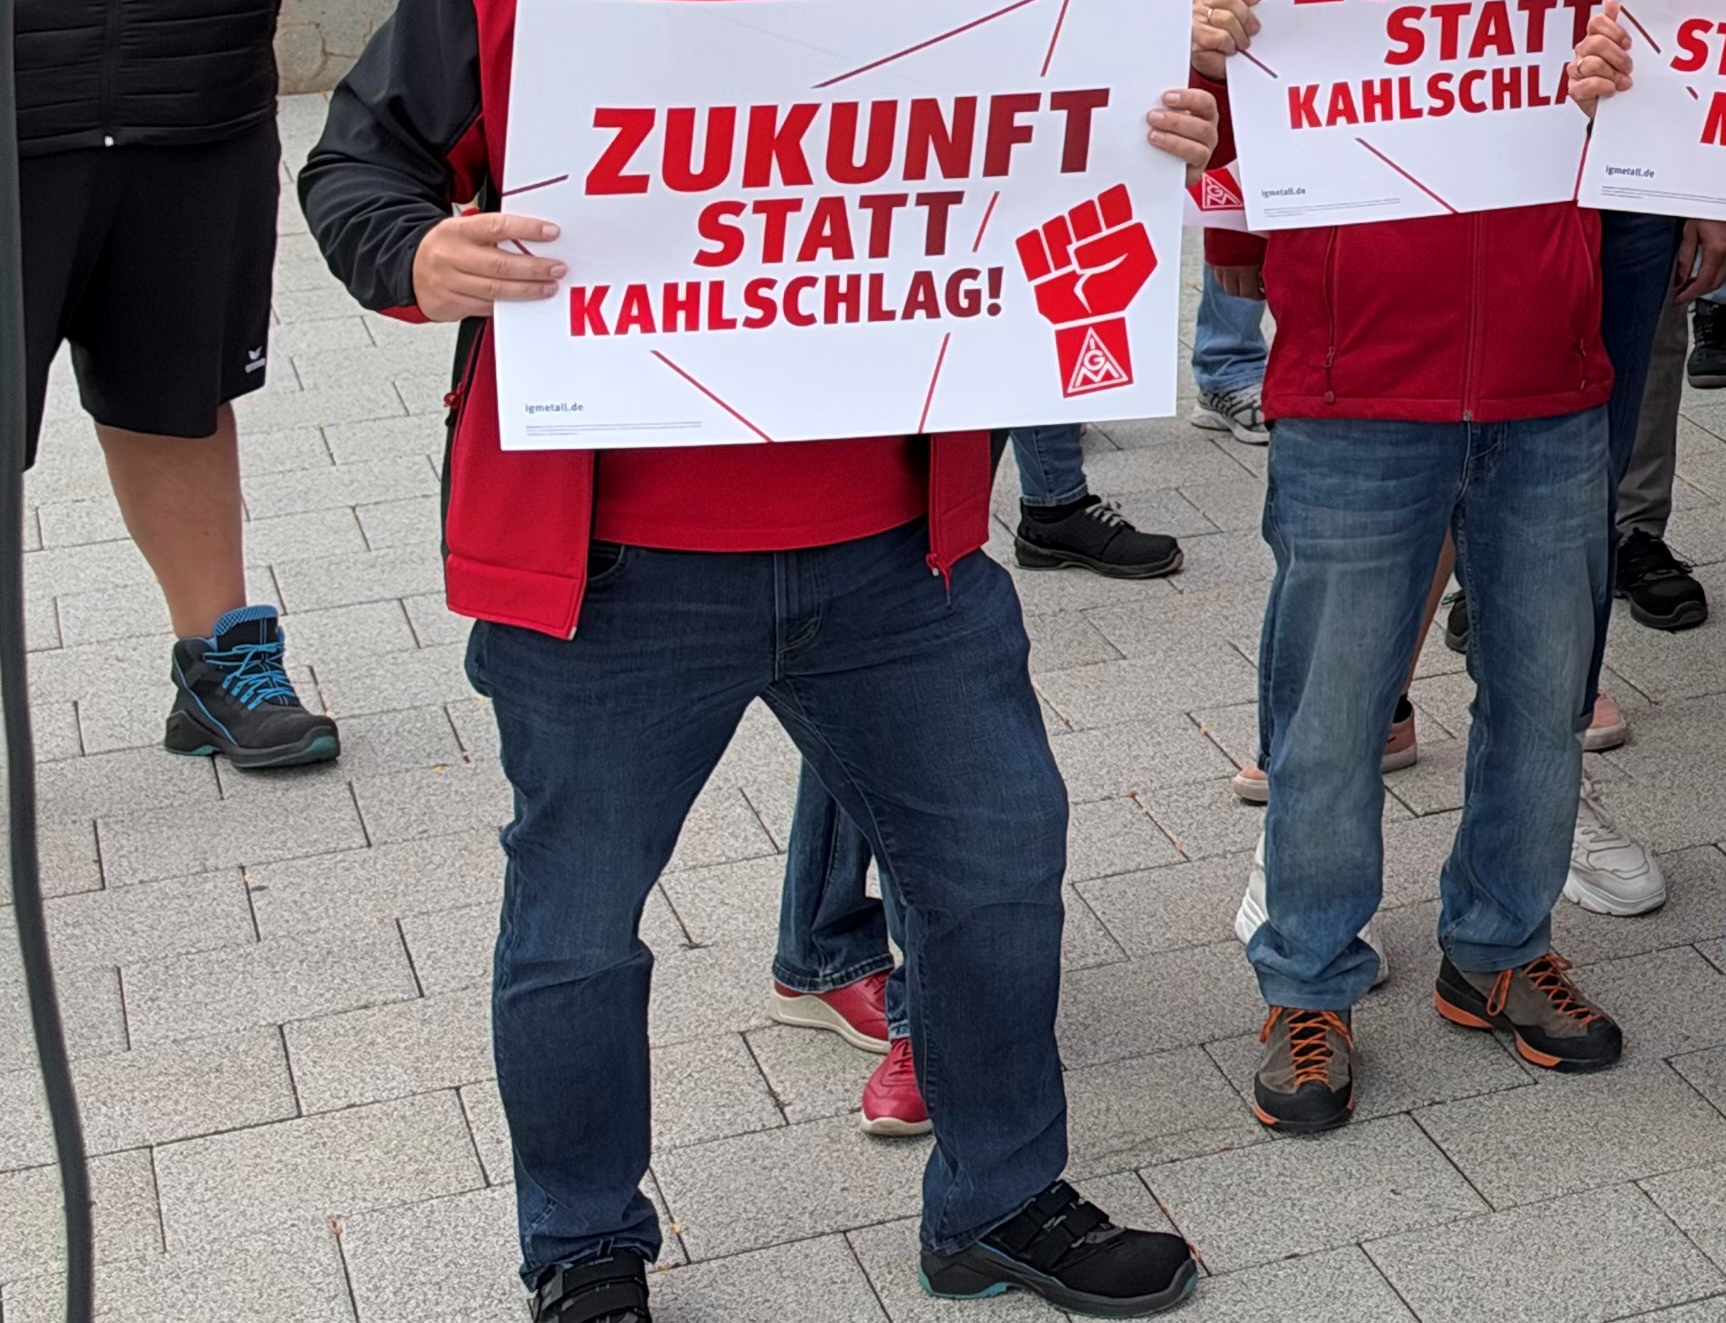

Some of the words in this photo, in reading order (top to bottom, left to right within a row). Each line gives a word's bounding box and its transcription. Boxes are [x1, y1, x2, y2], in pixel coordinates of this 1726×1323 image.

[1289, 64, 1569, 128] KAHLSCHL
[586, 89, 1108, 195] ZUKUNFT
[695, 192, 963, 267] STATT
[571, 268, 1002, 335] KAHLSCHLAG!
[1068, 329, 1130, 393] IGM
[525, 402, 584, 416] igmetall.de
